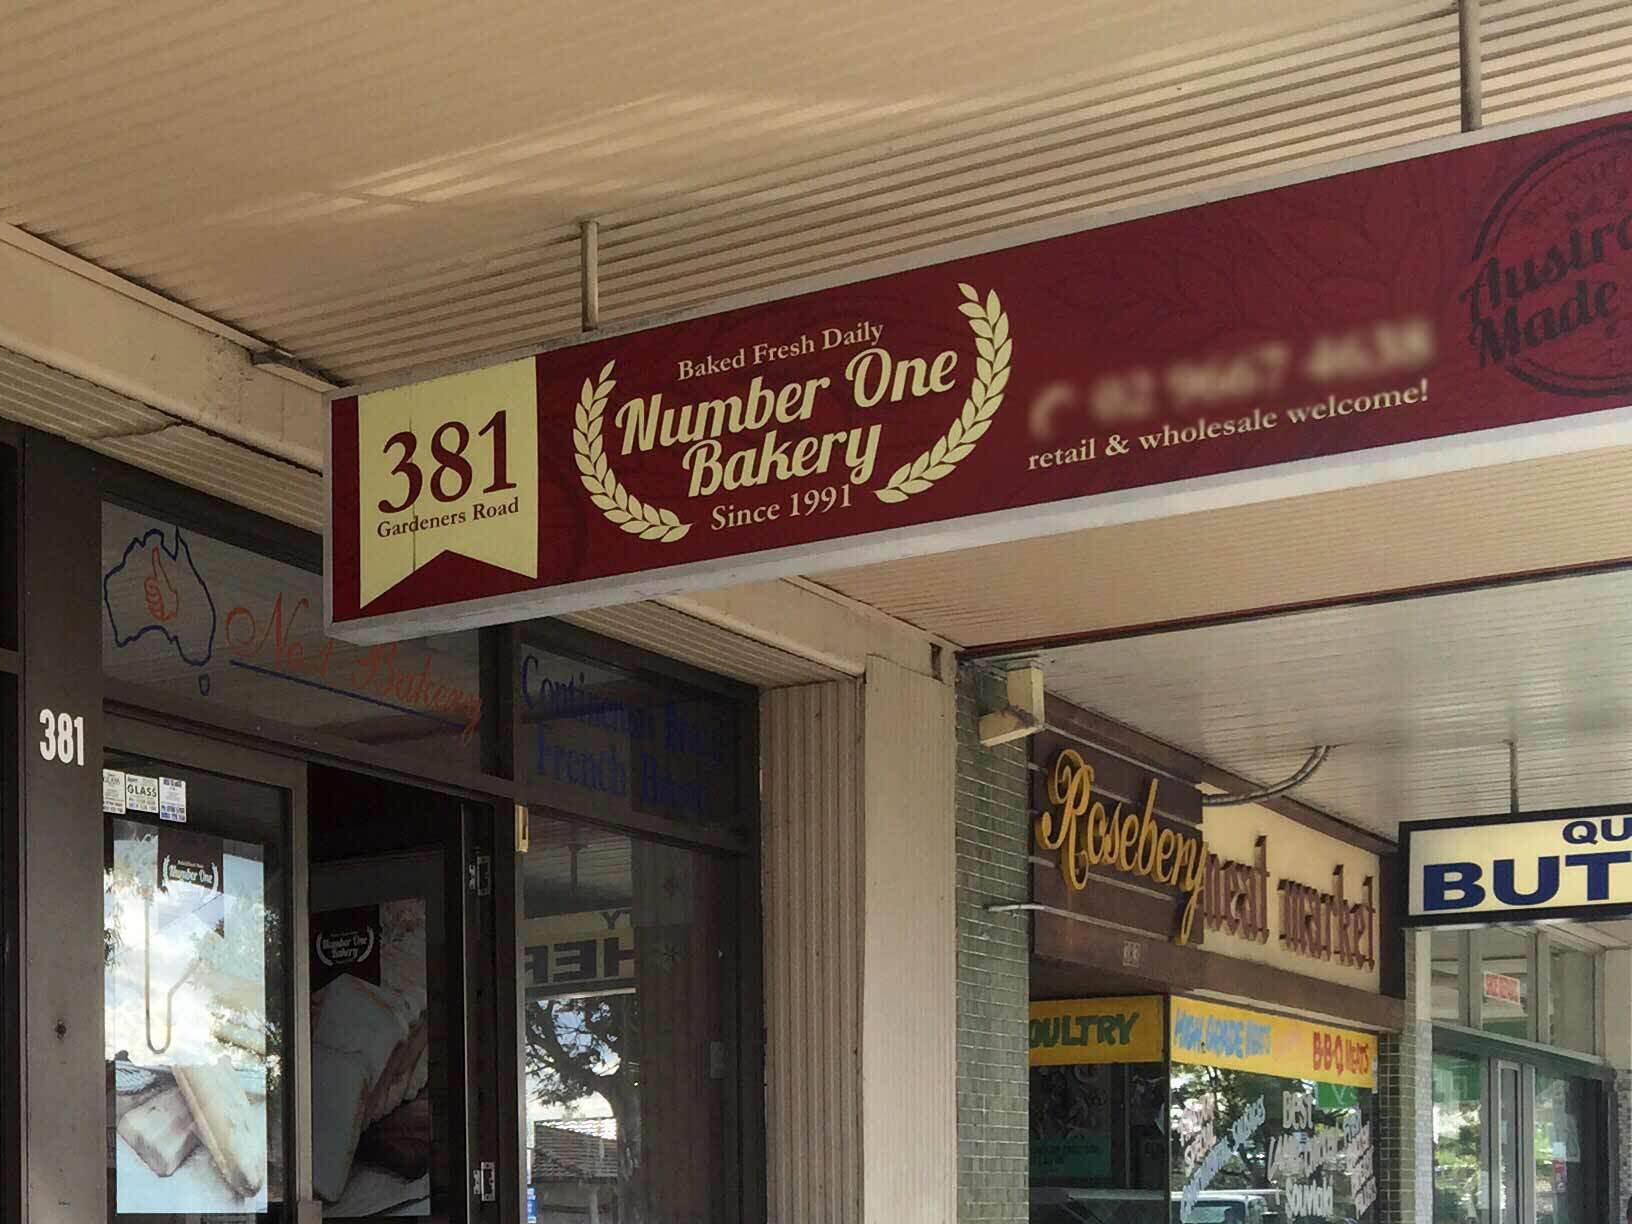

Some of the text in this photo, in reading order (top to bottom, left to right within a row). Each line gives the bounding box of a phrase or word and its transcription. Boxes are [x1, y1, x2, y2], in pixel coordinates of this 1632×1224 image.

[677, 321, 884, 381] Baked Fresh Daily
[1469, 280, 1619, 368] Made
[615, 376, 831, 456] Number
[845, 347, 958, 409] One
[1027, 377, 1430, 471] retail & wholesale welcome!
[378, 409, 517, 514] 381
[682, 423, 883, 498] Bakery
[377, 496, 519, 538] Gardeners Road
[711, 483, 853, 531] Since 1991
[39, 708, 84, 766] 381
[127, 784, 157, 798] GLASS
[1036, 749, 1208, 944] Rosebery
[1424, 851, 1631, 911] BUT
